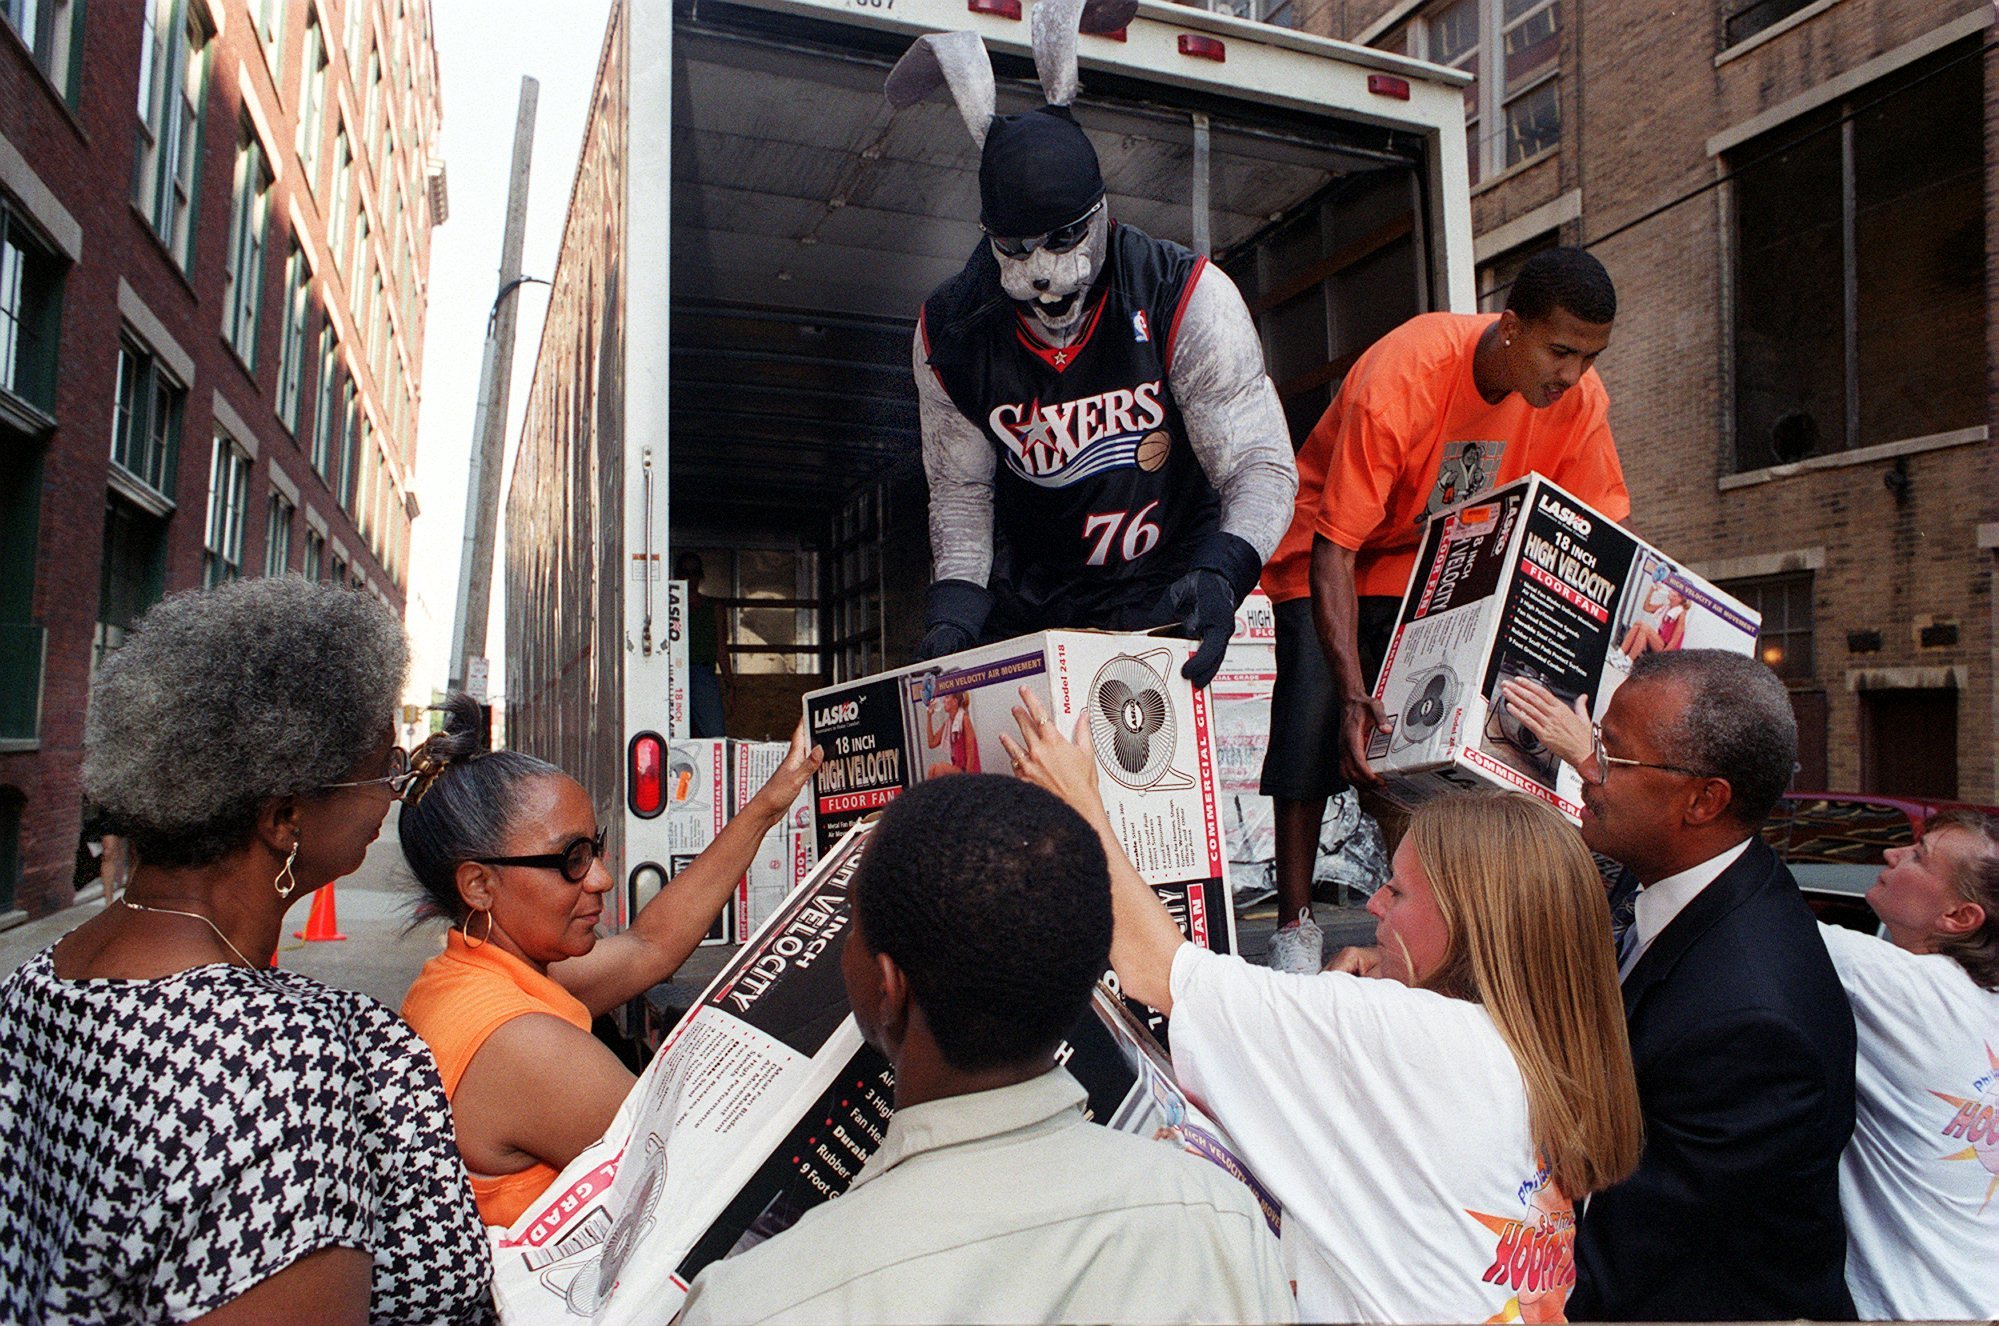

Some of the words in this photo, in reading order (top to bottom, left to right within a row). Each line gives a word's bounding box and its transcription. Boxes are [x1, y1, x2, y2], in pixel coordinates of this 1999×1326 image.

[1494, 495, 1520, 556] LASKO
[1538, 494, 1592, 535] LASKO
[1083, 500, 1161, 566] 76
[1473, 536, 1485, 548] 8
[1461, 549, 1478, 580] INCH
[1555, 532, 1570, 551] 18
[1570, 544, 1597, 569] INCH
[1430, 545, 1469, 612] VELOCITY
[1524, 532, 1559, 573] HIGH
[1558, 552, 1616, 607] VELOCITY
[1420, 580, 1436, 609] FAN
[1530, 567, 1570, 598] FLOOR
[1575, 596, 1600, 617] FAN
[1247, 610, 1272, 628] HIGH
[1256, 629, 1275, 637] FLO
[939, 679, 954, 691] HIGH
[956, 672, 986, 686] VELOCITY
[988, 669, 1001, 680] AIR
[1002, 658, 1042, 676] MOVEMENT
[1058, 644, 1067, 673] 2418
[1379, 633, 1400, 699] COMMERCI
[1061, 676, 1071, 714] Model
[1194, 690, 1205, 728] GRA
[675, 703, 683, 722] INCH
[815, 701, 859, 729] LASKO
[1451, 707, 1463, 735] Model
[836, 736, 850, 755] 18
[852, 734, 876, 752] INCH
[818, 758, 846, 793] HIGH
[846, 748, 899, 789] VELOCITY
[1465, 749, 1553, 803] COMMERCIAL
[1558, 799, 1581, 817] GRA
[828, 793, 866, 811] FLOOR
[871, 790, 895, 805] FAN
[1200, 736, 1218, 861] COMMERCIAL
[1193, 898, 1206, 949] FAN
[729, 895, 846, 1013] VELOCITY
[795, 914, 849, 968] INCH
[707, 1041, 740, 1077] Durable
[730, 1050, 756, 1077] Speeds
[740, 1059, 758, 1078] High
[760, 1060, 771, 1071] Air
[688, 1078, 707, 1098] Steel
[752, 1063, 777, 1091] Deliver
[762, 1066, 783, 1091] Metal
[879, 1070, 896, 1088] Air
[689, 1080, 716, 1110] Rotates
[695, 1079, 740, 1129] Performance
[721, 1073, 760, 1116] Movement
[747, 1091, 762, 1106] Fan
[865, 1088, 875, 1100] 3
[872, 1096, 895, 1119] High
[715, 1092, 752, 1133] Maximum
[723, 1107, 748, 1133] Blades
[850, 1107, 868, 1129] Fan
[867, 1123, 886, 1145] Hea
[816, 1143, 850, 1179] Rubber
[1209, 1142, 1247, 1184] VELOCITY
[800, 1162, 811, 1174] 9
[807, 1169, 831, 1195] Foot
[526, 1182, 593, 1243] GRAD
